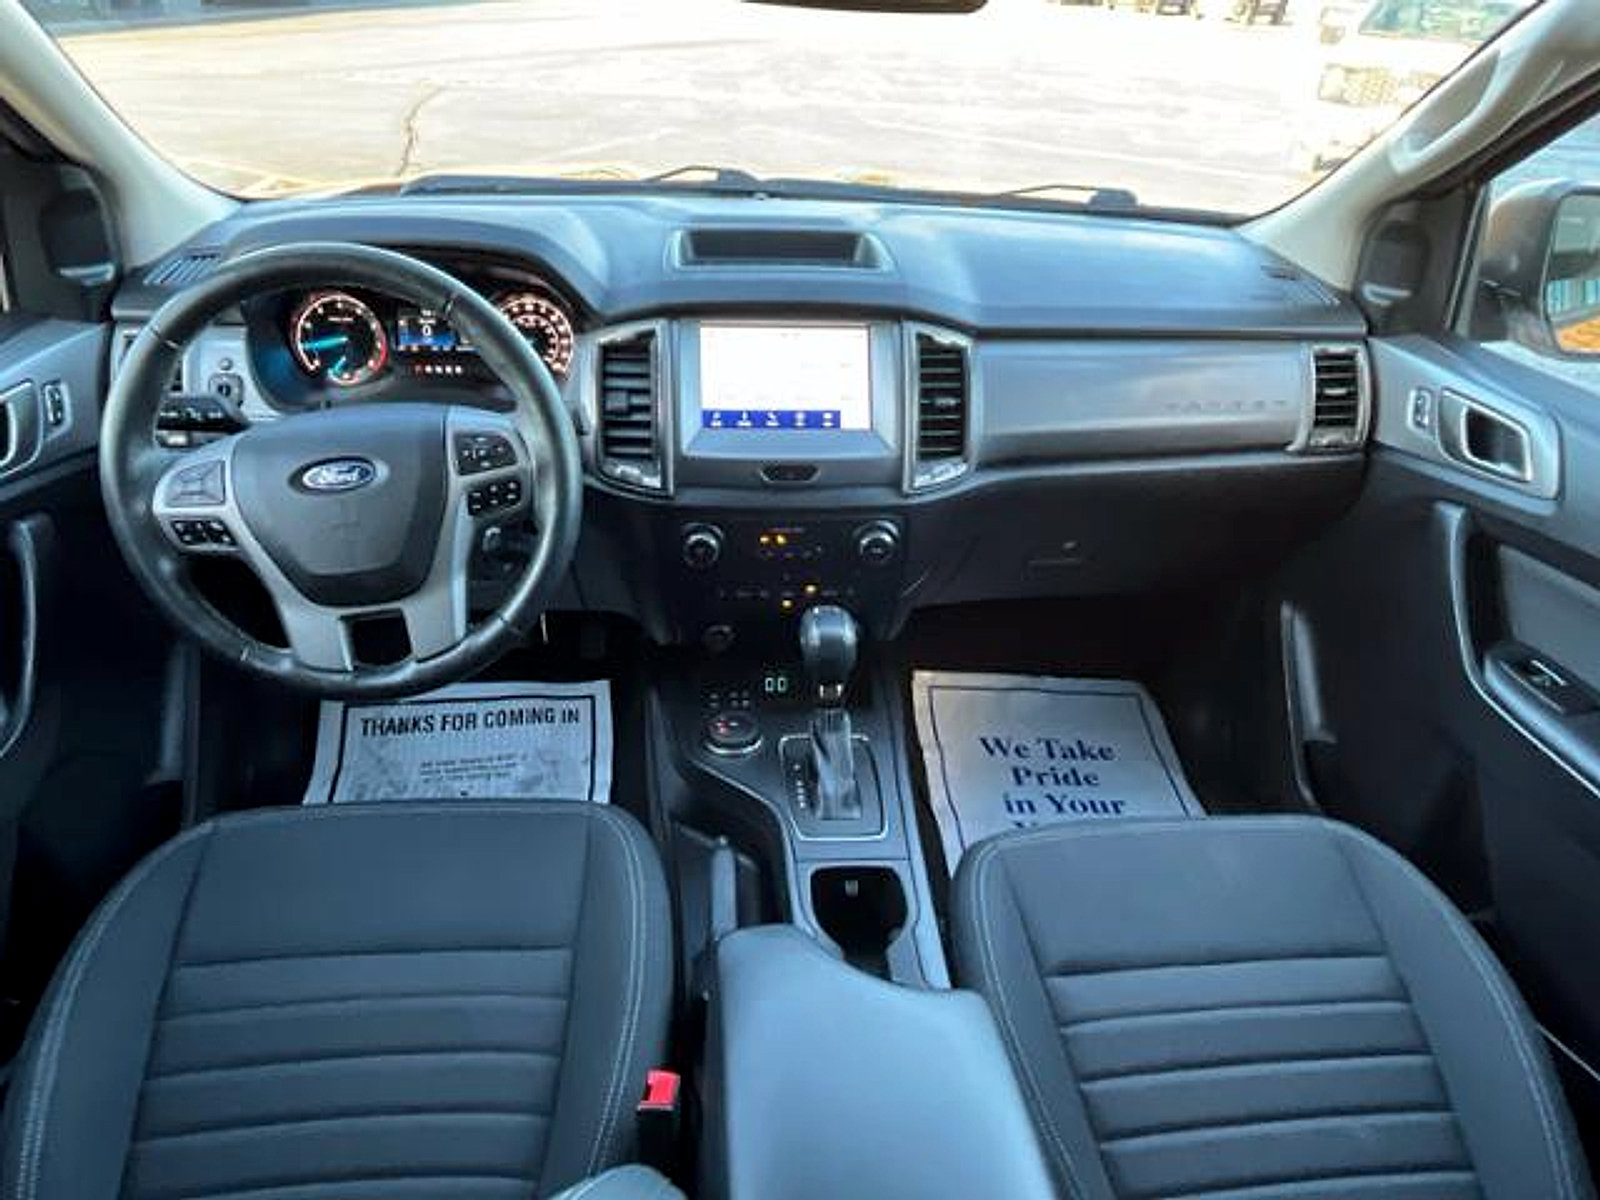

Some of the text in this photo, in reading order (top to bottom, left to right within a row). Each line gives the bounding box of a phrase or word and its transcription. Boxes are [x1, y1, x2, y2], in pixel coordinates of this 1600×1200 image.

[361, 706, 579, 736] THANKS FOR COMING IN
[979, 736, 1116, 761] We Take
[1010, 766, 1100, 787] Pride
[1004, 793, 1125, 815] in Your
